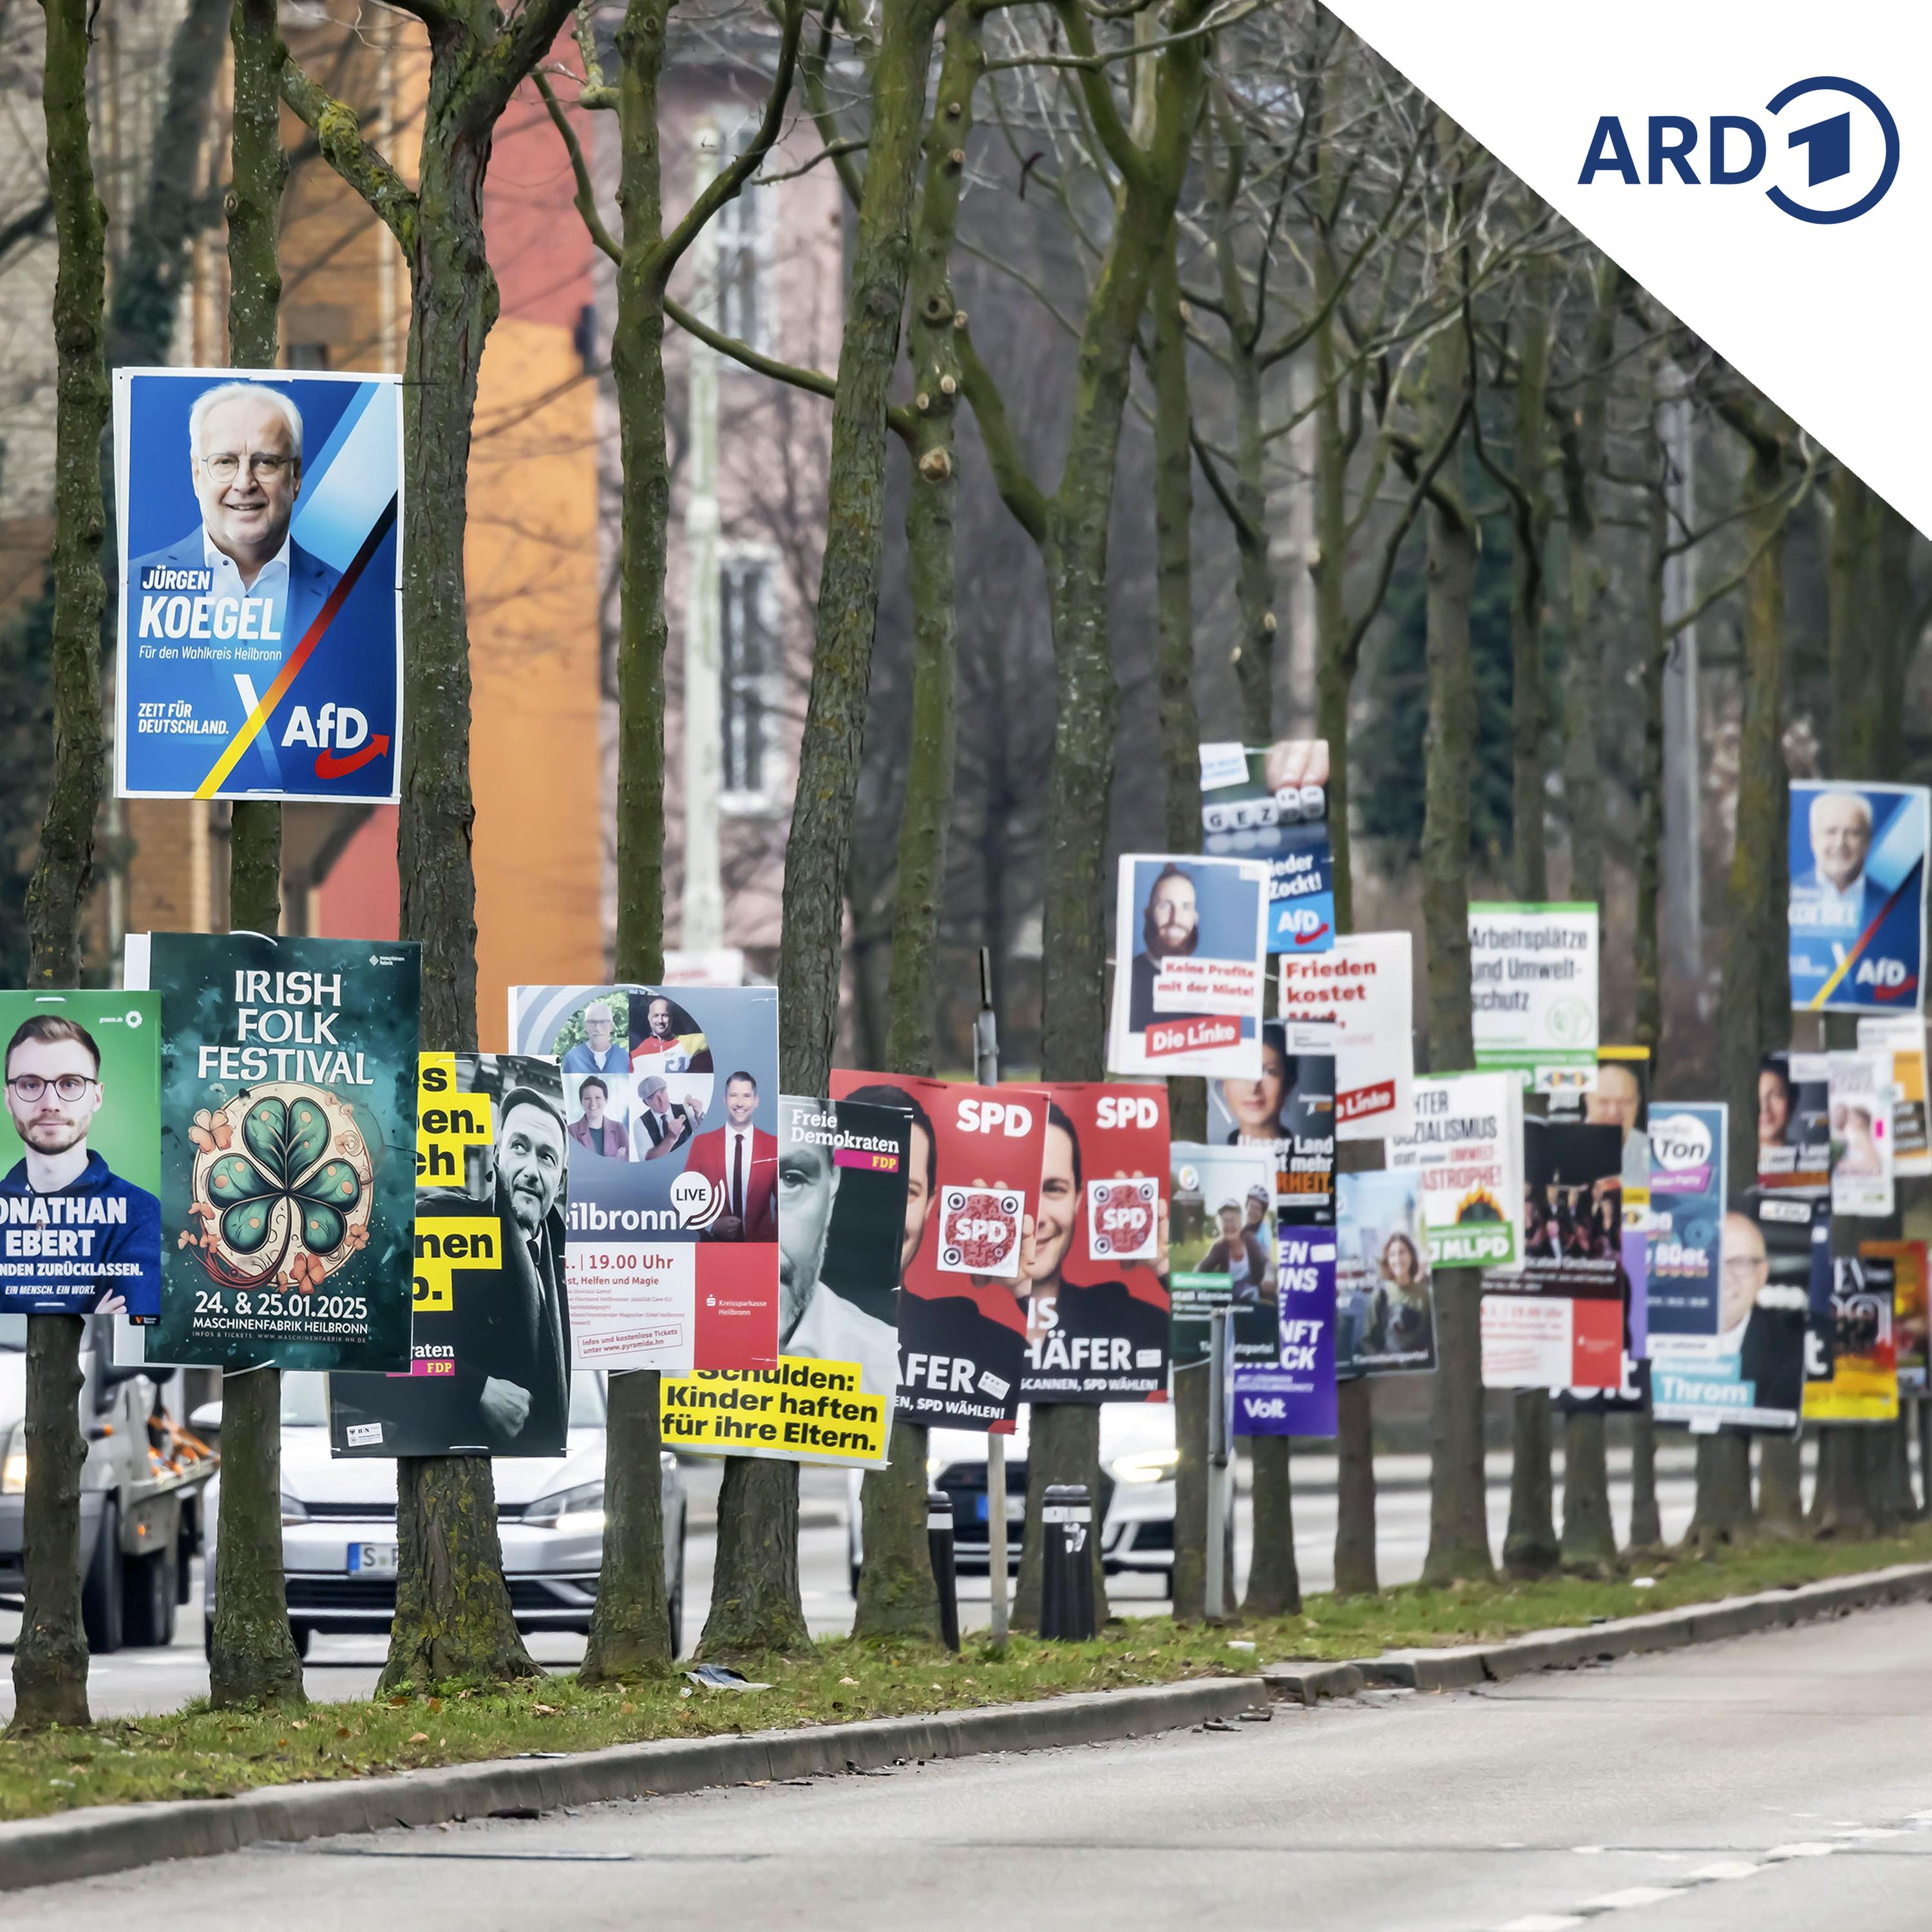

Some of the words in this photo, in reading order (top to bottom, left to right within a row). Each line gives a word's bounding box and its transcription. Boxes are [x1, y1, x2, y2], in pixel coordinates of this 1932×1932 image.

[142, 565, 210, 591] JÜRGEN
[138, 596, 281, 641] KOEGEL
[138, 645, 156, 660] Für
[159, 647, 178, 659] den
[182, 646, 231, 661] Wahlkreis
[234, 647, 282, 661] Heilbronn
[138, 703, 166, 718] ZEIT
[168, 701, 193, 718] FÜR
[138, 719, 229, 735] DEUTSCHLAND.
[281, 703, 369, 750] AfD
[1277, 909, 1320, 933] AfD
[1286, 959, 1377, 979] Frieden
[1857, 958, 1906, 985] AfD
[235, 970, 341, 1007] IRISH
[1158, 981, 1181, 992] mit
[1188, 982, 1208, 992] der
[1287, 983, 1365, 1004] kostet
[238, 1008, 340, 1045] FOLK
[1153, 1028, 1185, 1051] Die
[198, 1045, 375, 1084] FESTIVAL
[422, 1067, 448, 1092] s
[417, 1108, 485, 1135] en.
[791, 1108, 838, 1128] Freie
[956, 1099, 1032, 1137] SPD
[1097, 1097, 1159, 1130] SPD
[790, 1126, 900, 1153] Demokraten
[1294, 1134, 1334, 1155] Land
[1661, 1141, 1705, 1159] Ton
[872, 1156, 896, 1170] FDP
[1290, 1153, 1334, 1172] mehr
[676, 1188, 706, 1202] LIVE
[955, 1218, 1009, 1243] SPD
[1103, 1208, 1148, 1231] SPD
[6, 1229, 96, 1256] EBERT
[1444, 1236, 1509, 1261] MLPD
[37, 1260, 144, 1277] ZURÜCKLASSEN.
[589, 1254, 638, 1269] 19.00
[643, 1254, 674, 1269] Uhr
[5, 1285, 18, 1295] EIN
[19, 1285, 54, 1295] MENSCH.
[56, 1285, 71, 1295] EIN
[71, 1285, 96, 1295] WORT.
[581, 1276, 610, 1285] Helfen
[612, 1276, 630, 1285] und
[632, 1276, 659, 1287] Magie
[194, 1291, 229, 1314] 24.
[235, 1292, 252, 1314] &
[257, 1293, 368, 1320] 25.01.2025
[719, 1300, 767, 1308] Kreissparkasse
[193, 1317, 301, 1332] MASCHINENFABRIK
[305, 1321, 368, 1334] HEILBRONN
[601, 1336, 614, 1345] und
[654, 1329, 678, 1338] Tickets
[583, 1346, 601, 1354] unter
[603, 1339, 665, 1352] www.pyramide.hn
[427, 1362, 453, 1374] FDP
[897, 1342, 976, 1394] FER
[1083, 1378, 1107, 1391] SPD
[1109, 1376, 1159, 1391] WÄHLEN!
[1661, 1376, 1749, 1404] Throm
[667, 1386, 773, 1412] Kinder
[780, 1392, 878, 1423] haften
[916, 1397, 943, 1412] SPD
[946, 1400, 1005, 1420] WÄHLEN!
[1243, 1397, 1287, 1419] Volt
[662, 1413, 708, 1437] für
[714, 1416, 777, 1441] ihre
[784, 1421, 876, 1451] Eltern.
